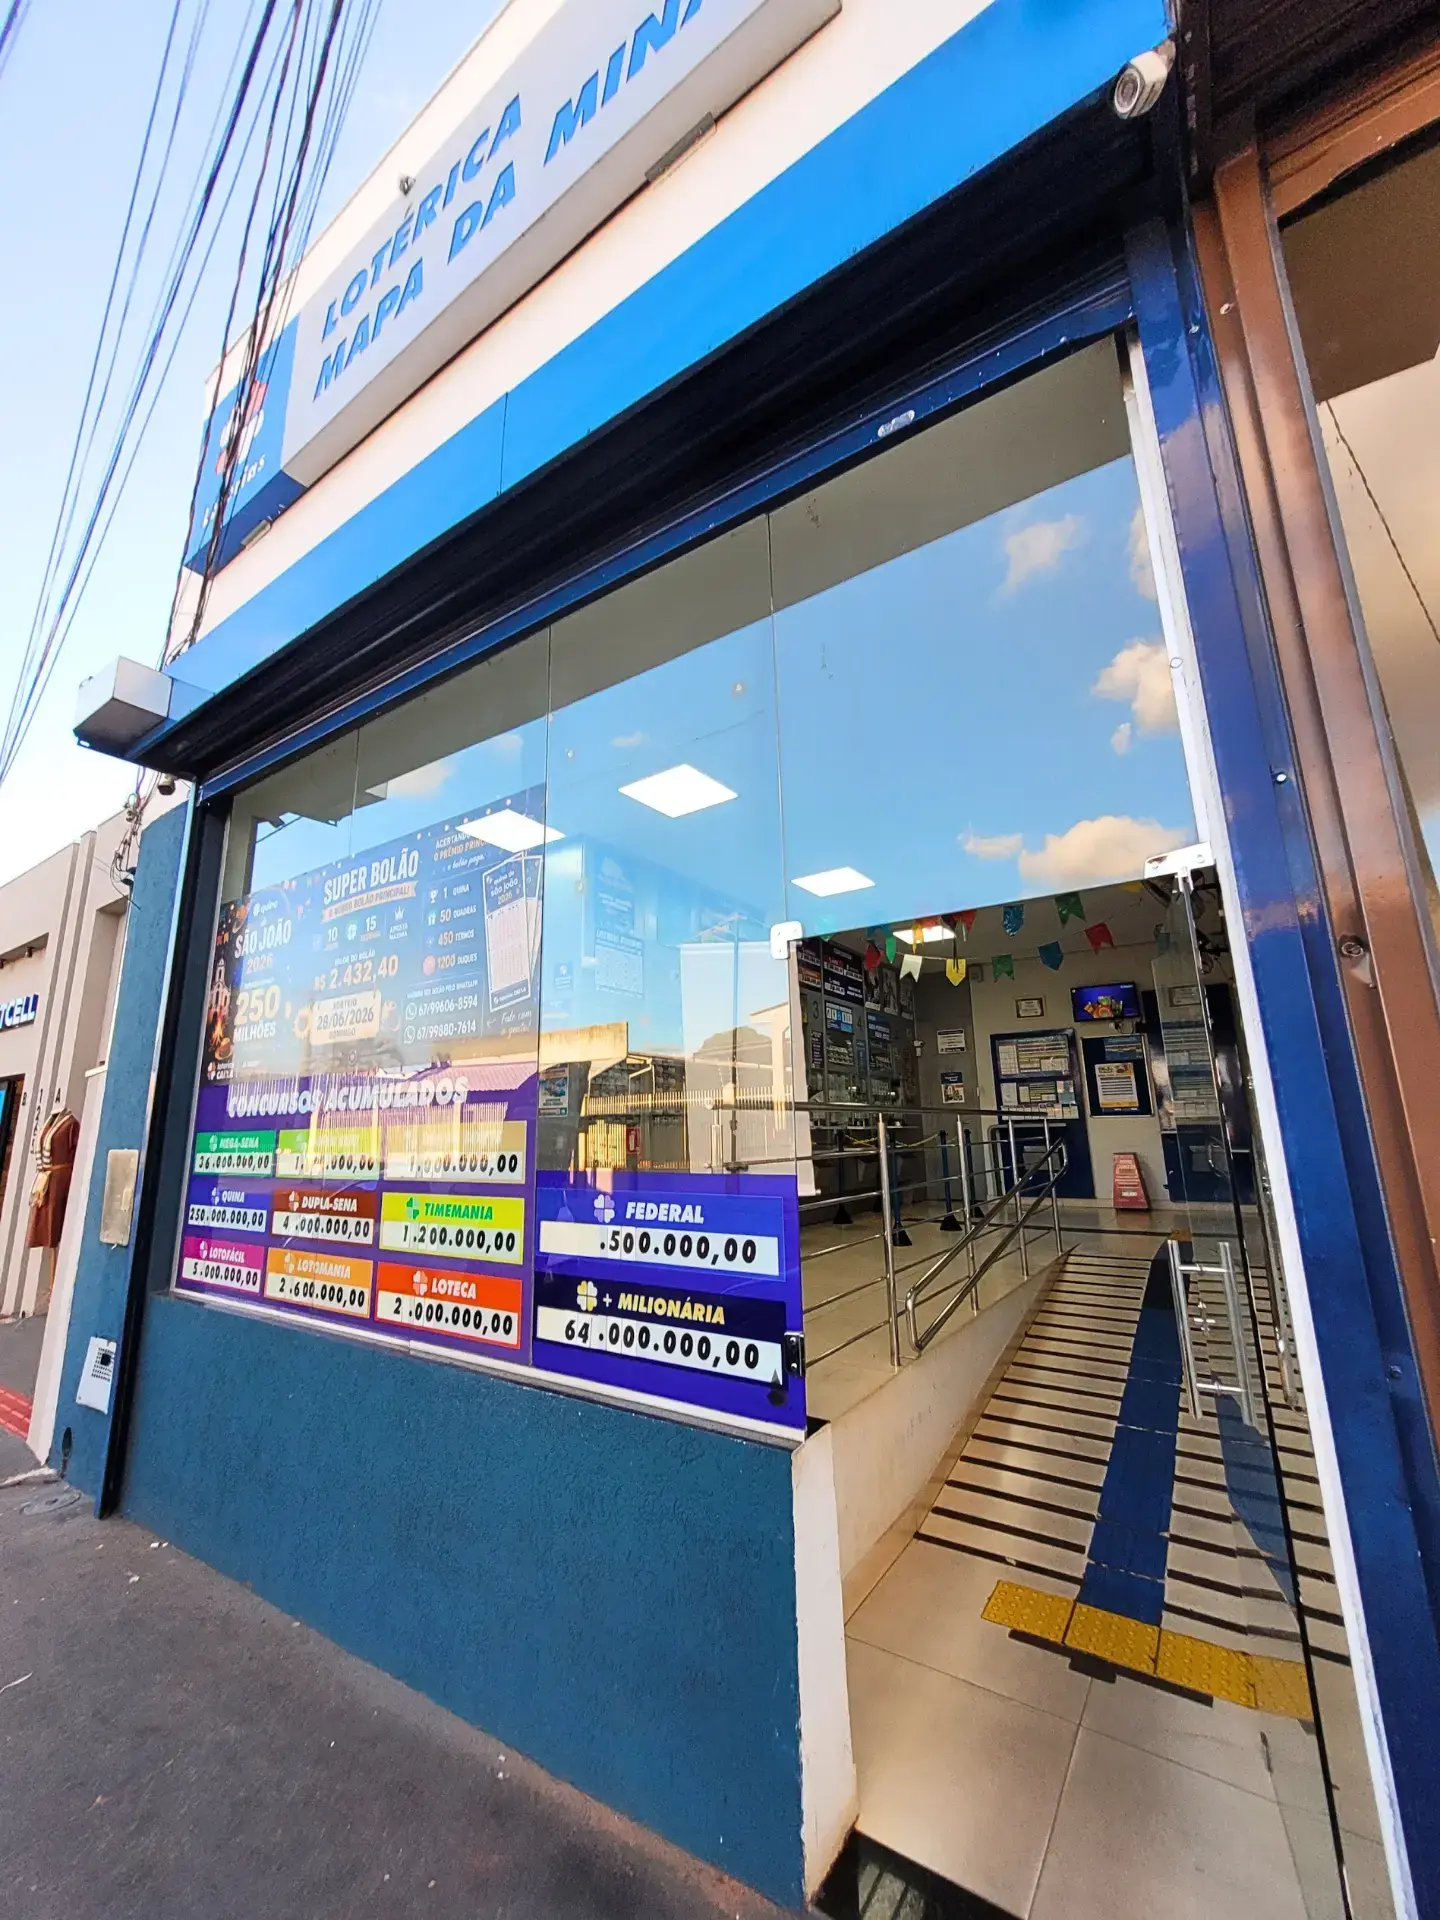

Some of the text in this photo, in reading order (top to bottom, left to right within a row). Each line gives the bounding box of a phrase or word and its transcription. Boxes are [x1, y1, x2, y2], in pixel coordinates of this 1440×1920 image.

[313, 0, 702, 402] MAPA DA MIN
[321, 93, 521, 343] LOTÉRICA
[465, 839, 489, 853] PRINC
[323, 847, 419, 905] SUPER BOLÃO
[443, 884, 470, 899] 1 QUINA
[366, 915, 377, 932] 15
[440, 905, 477, 923] 50 QUADRAS
[235, 918, 291, 958] SÃO JOÃO
[328, 926, 338, 942] 10
[438, 929, 475, 946] 450 TERNOS
[246, 952, 273, 974] 2026
[438, 952, 478, 969] 1200 DUQUES
[329, 953, 399, 990] 2.432,40
[234, 984, 281, 1025] 250
[418, 994, 478, 1017] 67/99606-8594
[812, 1000, 820, 1019] 3
[316, 1006, 374, 1030] 28/06/2026
[233, 1019, 276, 1043] MILHÕES
[417, 1019, 476, 1040] 67/99880-7614
[228, 1076, 469, 1117] CONCURSOS ACUMULADOS
[219, 1137, 259, 1149] MEGA-SENA
[222, 1190, 245, 1203] QUINA
[301, 1195, 358, 1213] DUPLA-SENA
[189, 1208, 264, 1228] 250.000.000,00
[425, 1203, 493, 1220] TIMEMANIA
[625, 1202, 704, 1223] FEDERAL
[403, 1225, 515, 1254] 1.200.000,00
[600, 1230, 757, 1266] .500.000,00
[209, 1246, 245, 1264] LOTOFÁCIL
[297, 1258, 351, 1279] LOTOMANIA
[431, 1278, 477, 1300] LOTECA
[618, 1296, 725, 1325] MILIONÁRIA
[564, 1320, 759, 1369] 64.000.000,00
